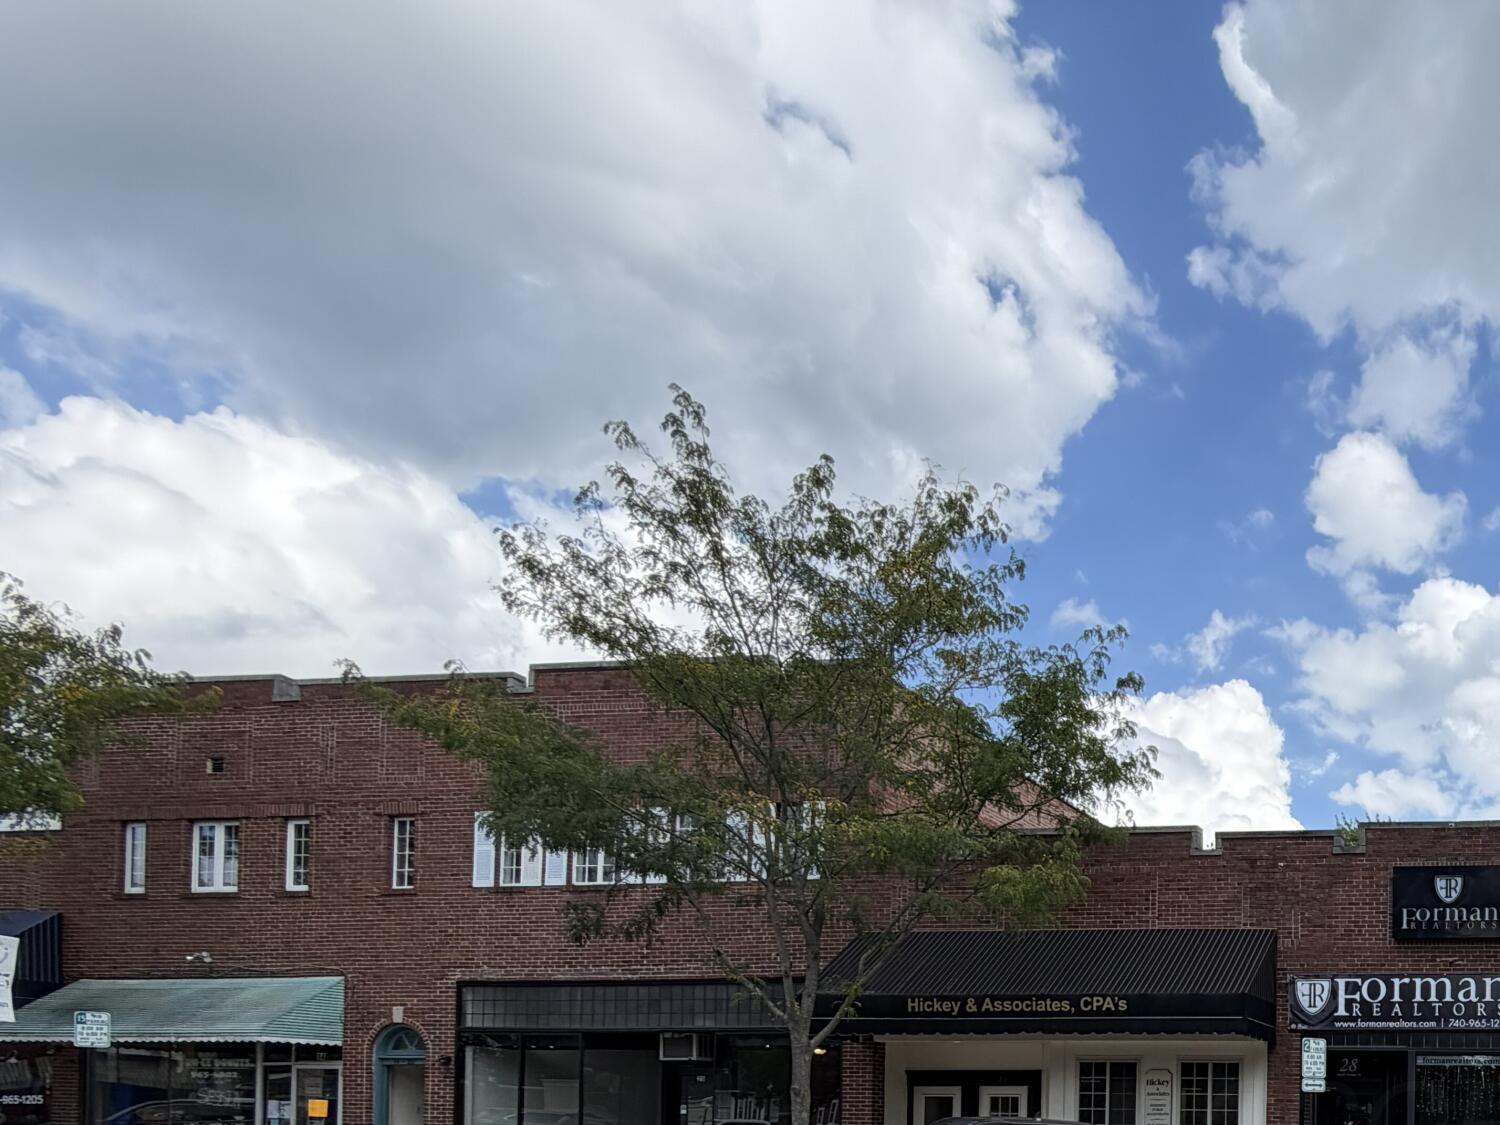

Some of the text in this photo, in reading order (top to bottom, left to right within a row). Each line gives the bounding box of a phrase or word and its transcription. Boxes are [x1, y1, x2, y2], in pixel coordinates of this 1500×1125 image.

[1401, 907, 1498, 930] Forman
[1411, 921, 1498, 930] REALTORS
[907, 996, 1128, 1015] Hickey & Associates, CPA's
[1334, 1018, 1436, 1028] www.formanrealtors.com
[1339, 1058, 1358, 1072] 28
